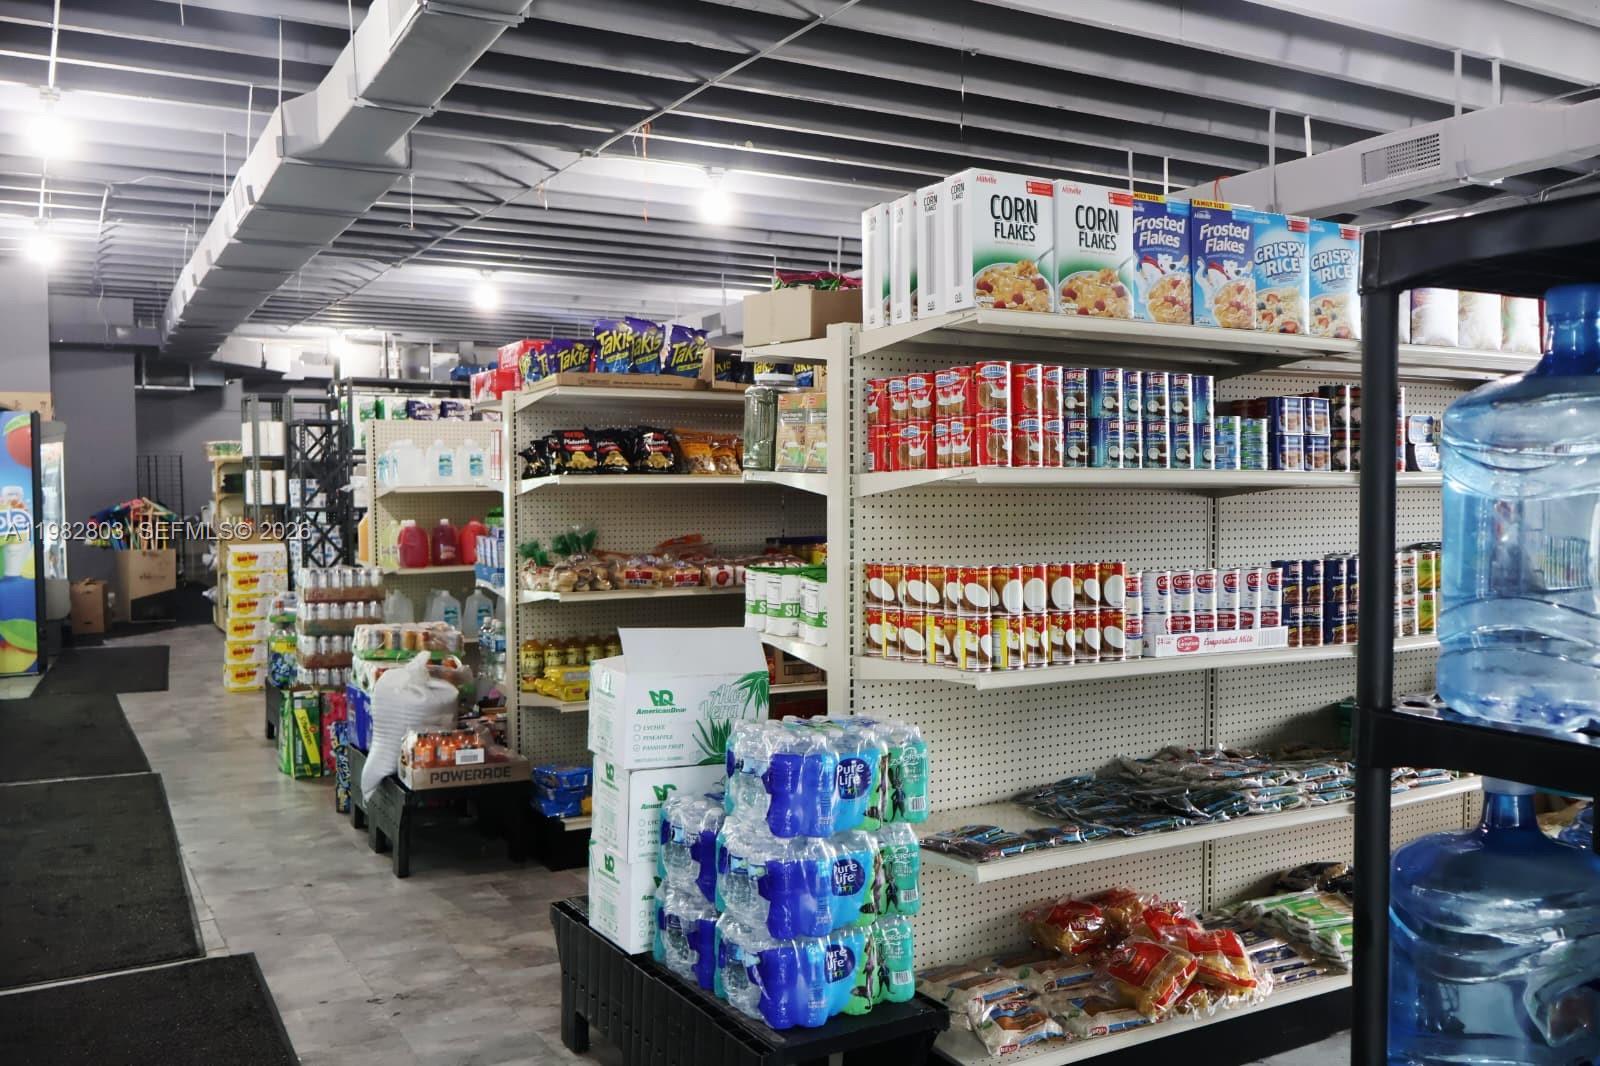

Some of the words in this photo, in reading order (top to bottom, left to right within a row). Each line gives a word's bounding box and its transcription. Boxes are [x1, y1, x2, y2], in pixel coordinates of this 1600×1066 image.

[950, 182, 965, 194] CORN
[923, 194, 938, 206] CORN
[990, 194, 1039, 224] CORN
[1193, 199, 1213, 208] FAMILY
[1213, 201, 1225, 210] SIZE
[1075, 205, 1119, 233] CORN
[1133, 216, 1186, 235] Frosted
[994, 222, 1036, 242] FLAKES
[1079, 231, 1117, 251] FLAKES
[1138, 229, 1181, 248] Flakes
[1199, 222, 1250, 241] Frosted
[1204, 237, 1246, 254] Flakes
[1254, 241, 1305, 265] CRISPY
[1265, 259, 1301, 278] RICE
[1310, 248, 1357, 272] CRISPY
[1321, 266, 1354, 284] RICE
[558, 347, 589, 371] Takis
[430, 766, 512, 784] POWERADE
[837, 760, 865, 776] Pure
[839, 774, 861, 787] Life
